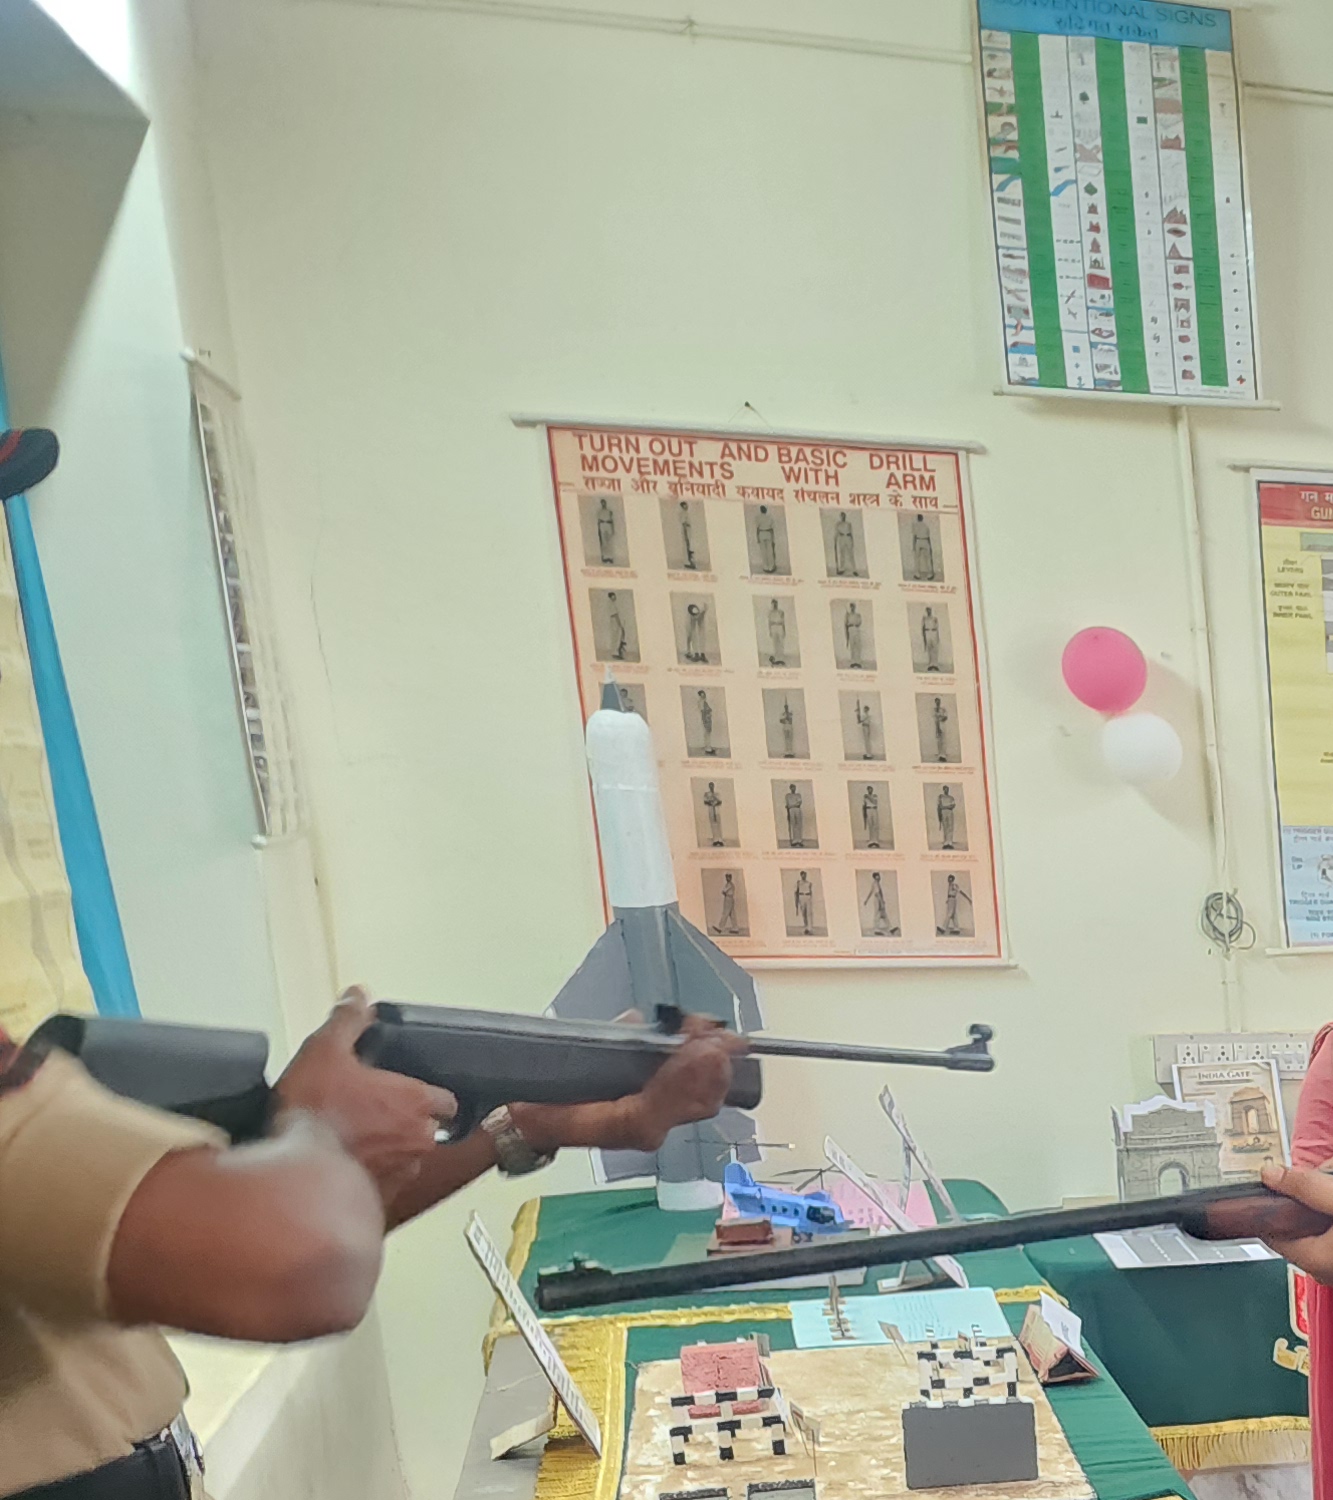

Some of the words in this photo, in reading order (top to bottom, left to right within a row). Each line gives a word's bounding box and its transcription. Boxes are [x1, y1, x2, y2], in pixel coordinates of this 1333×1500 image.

[1157, 9, 1217, 28] SIGNS
[575, 431, 641, 456] TURN
[648, 436, 699, 459] OUT
[720, 441, 770, 463] AND
[777, 444, 849, 470] BASIC
[869, 452, 937, 474] DRILL
[580, 452, 735, 481] MOVEMENTS
[782, 465, 840, 488] WITH
[885, 470, 937, 493] ARM
[1198, 1071, 1225, 1081] INDIA
[1226, 1070, 1251, 1079] GATE
